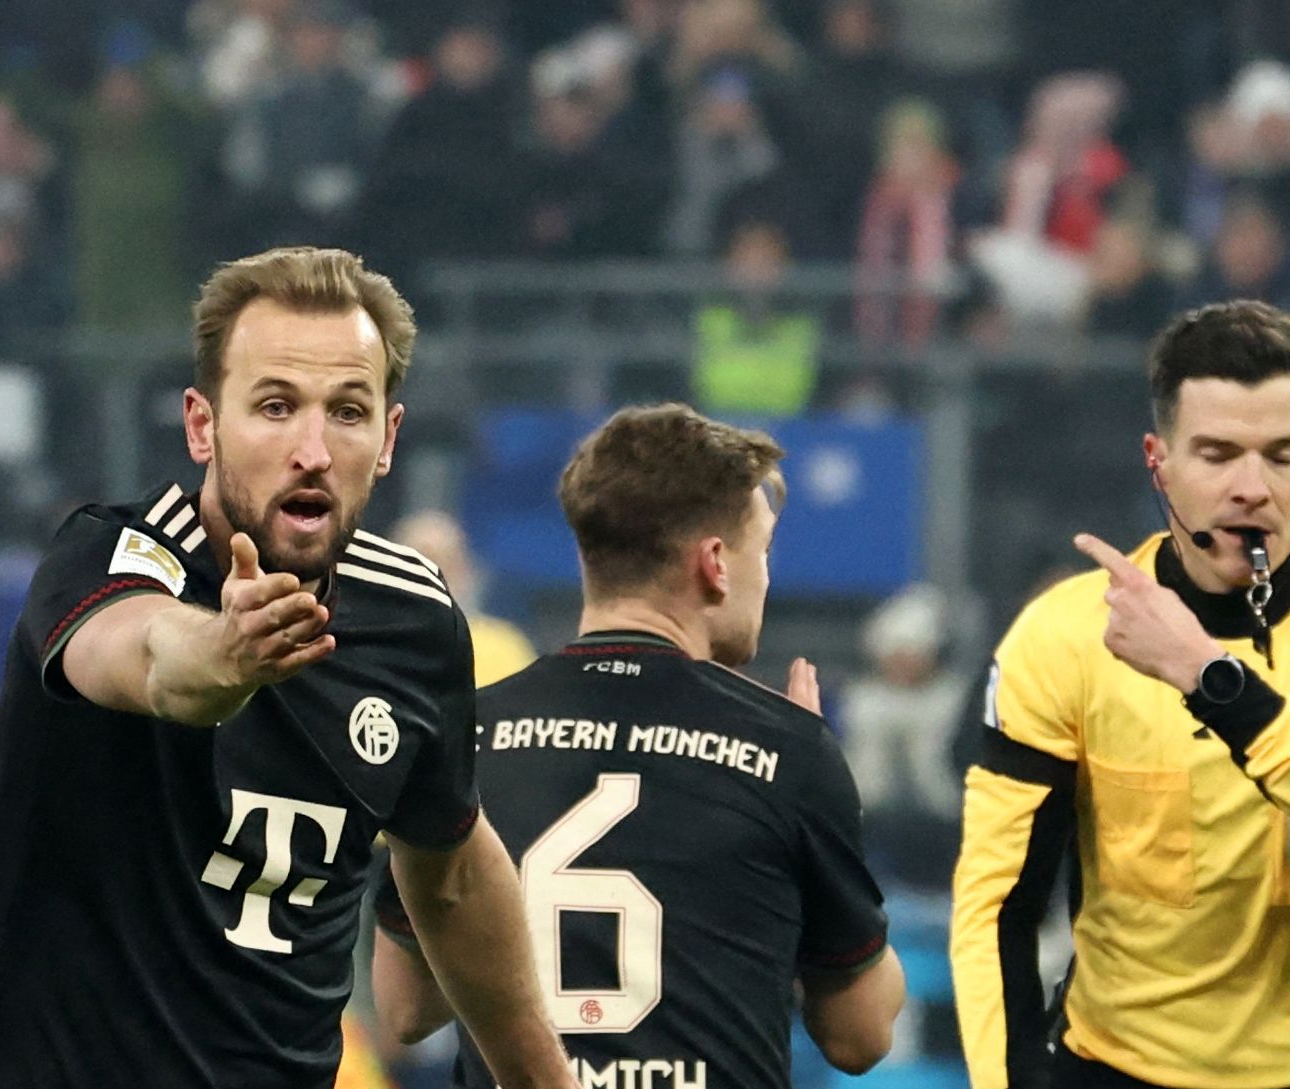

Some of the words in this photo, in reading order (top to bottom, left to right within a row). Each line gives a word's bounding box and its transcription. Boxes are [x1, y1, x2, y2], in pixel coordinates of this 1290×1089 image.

[492, 717, 618, 751] BAYERN
[628, 724, 780, 783] MÜNCHEN
[520, 772, 663, 1034] 6
